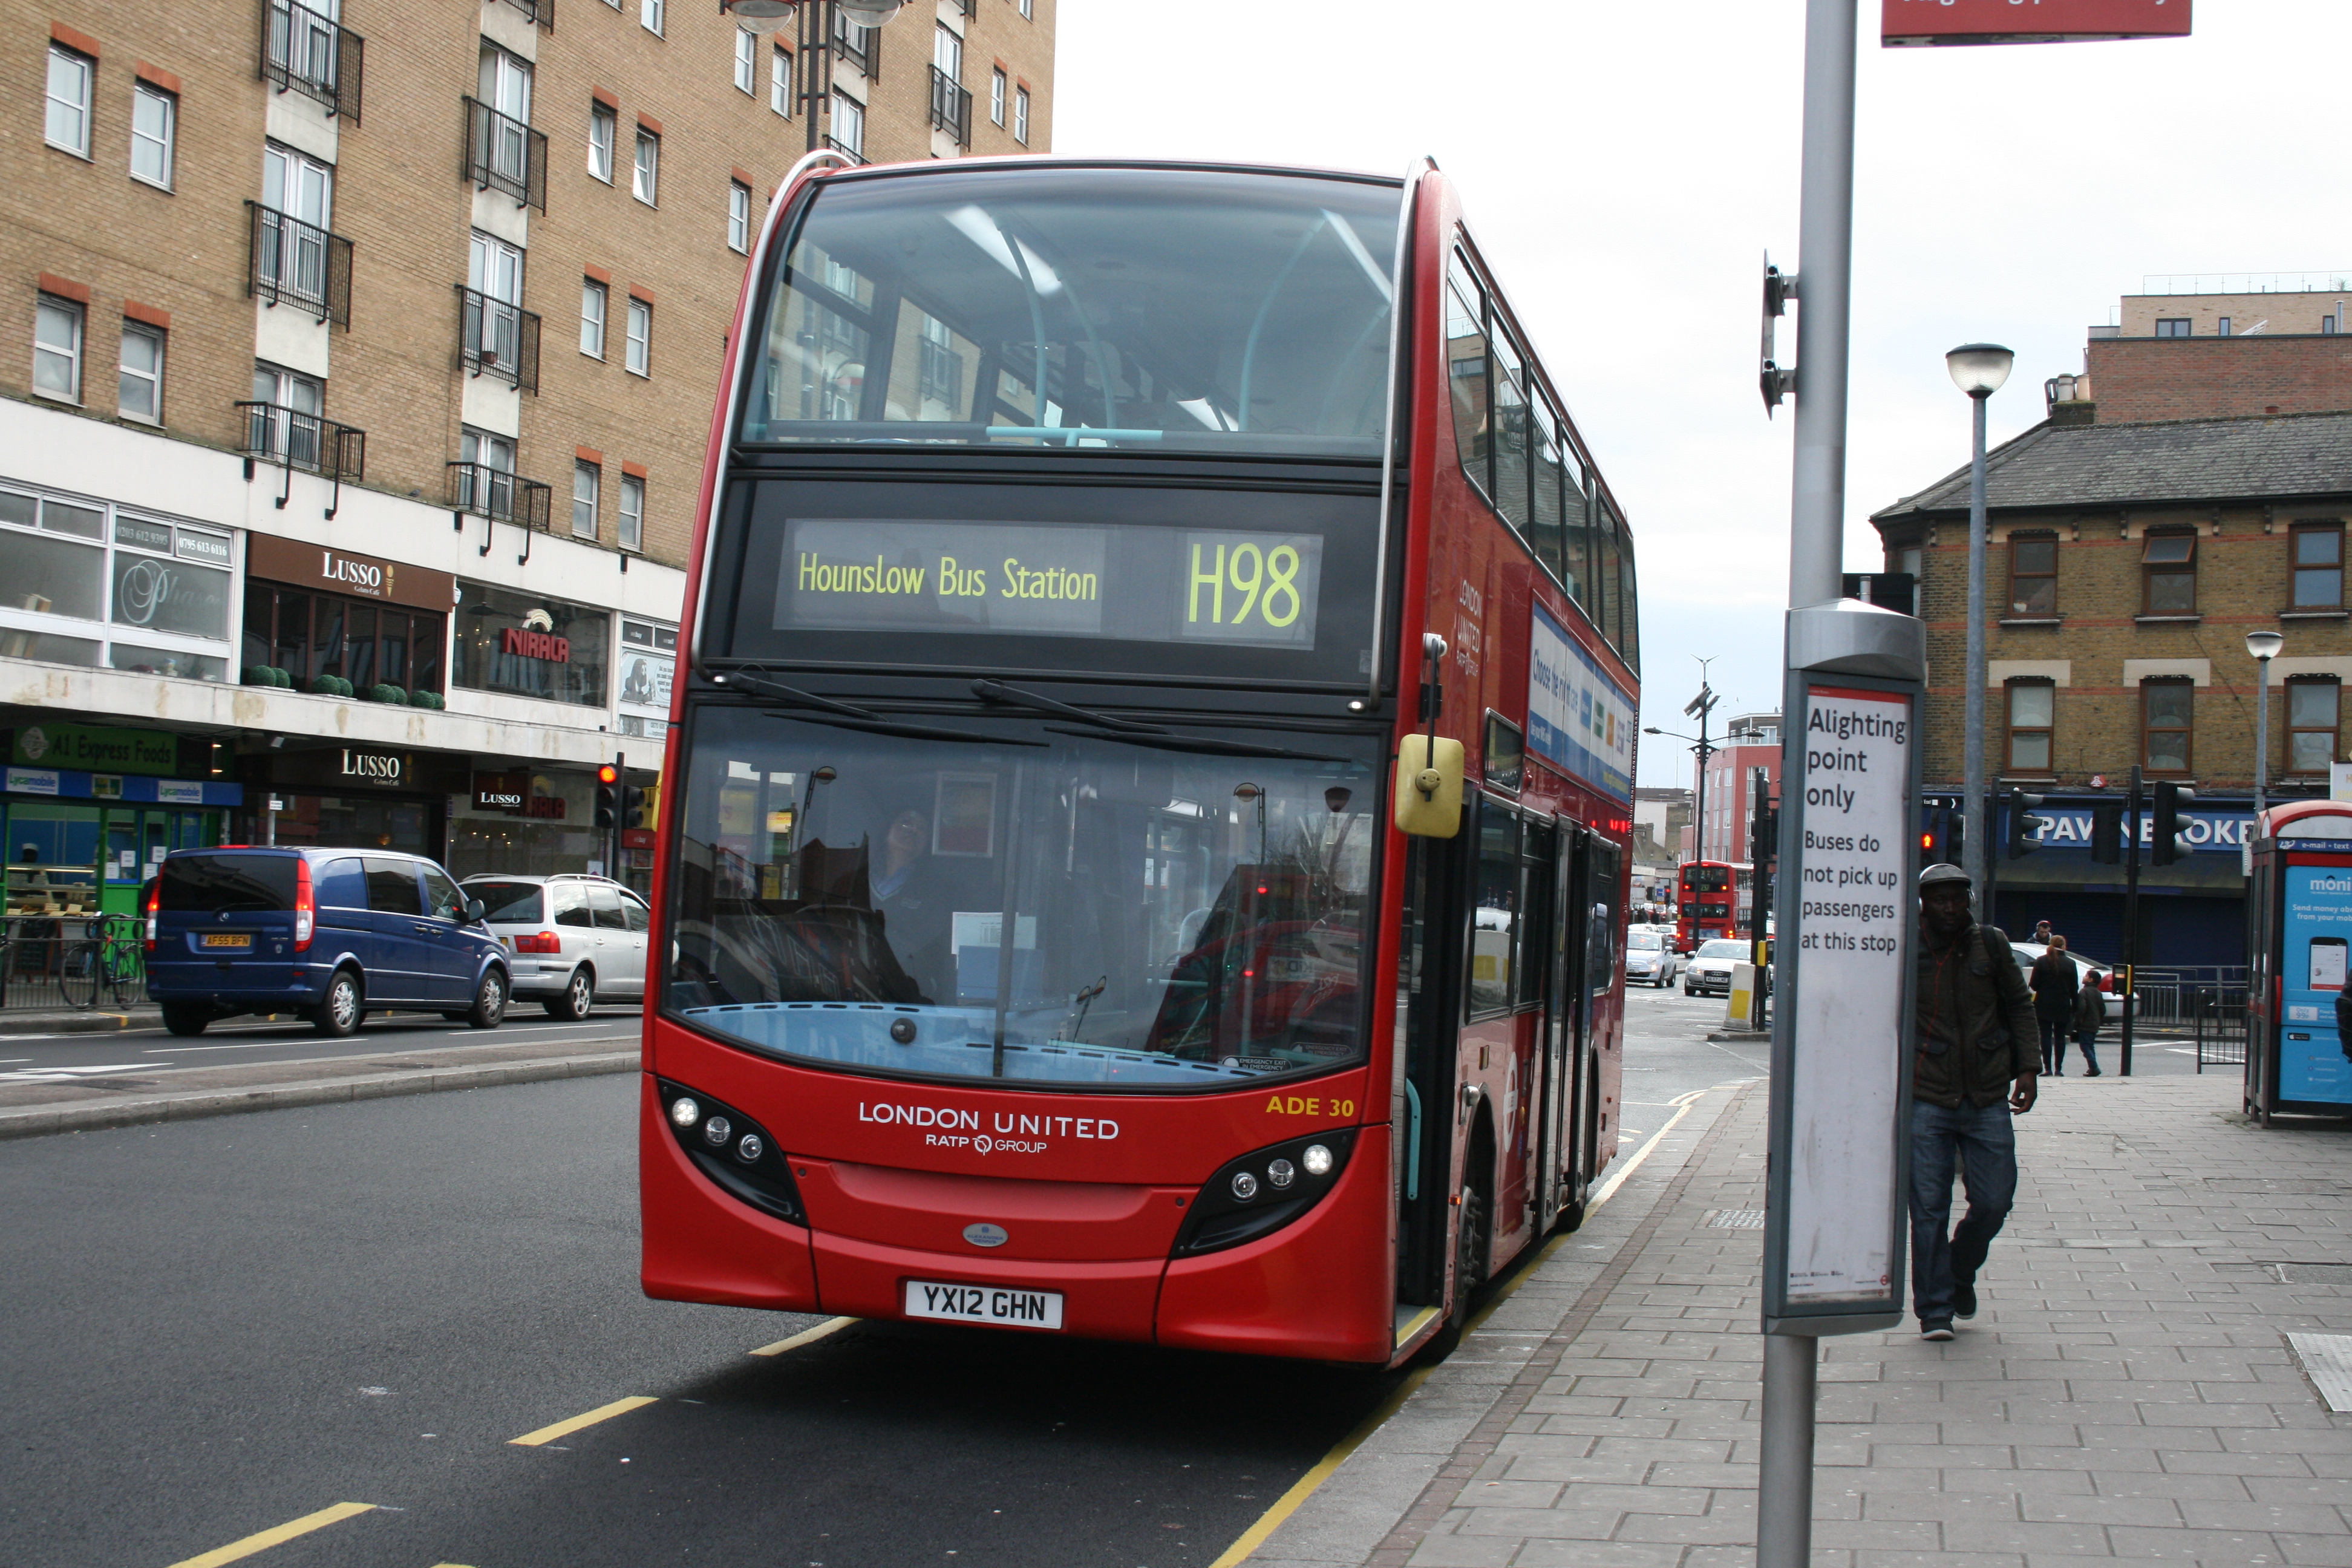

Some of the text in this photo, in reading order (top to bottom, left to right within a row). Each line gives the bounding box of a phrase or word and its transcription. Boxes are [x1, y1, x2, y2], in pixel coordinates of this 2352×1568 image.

[179, 537, 227, 557] 0795 613 6116
[322, 551, 381, 587] LUSSO
[799, 552, 1097, 601] Hounslow Bus Station
[1189, 543, 1301, 627] H98
[1459, 578, 1482, 619] LONDON
[505, 627, 570, 663] NIRALA
[1458, 613, 1480, 653] UNITED
[1808, 708, 1906, 745] Alighting
[53, 733, 71, 756] A1
[77, 734, 130, 766] Express
[135, 739, 172, 764] Foods
[341, 748, 400, 778] LUSSO
[1808, 746, 1867, 775] point
[9, 773, 56, 788] Lycamobile
[160, 785, 200, 798] Lycamobile
[480, 792, 521, 804] LUSSO
[1806, 783, 1855, 814] only
[1805, 831, 1880, 852] Buses do
[1804, 866, 1898, 890] not pick up
[1803, 901, 1895, 923] passengers
[1801, 932, 1896, 956] at this stop
[859, 1102, 1119, 1140] LONDON UNITED
[1266, 1096, 1354, 1117] ADE 30
[926, 1134, 1047, 1154] RATP GROUP
[924, 1285, 1045, 1321] YX12 GHN
